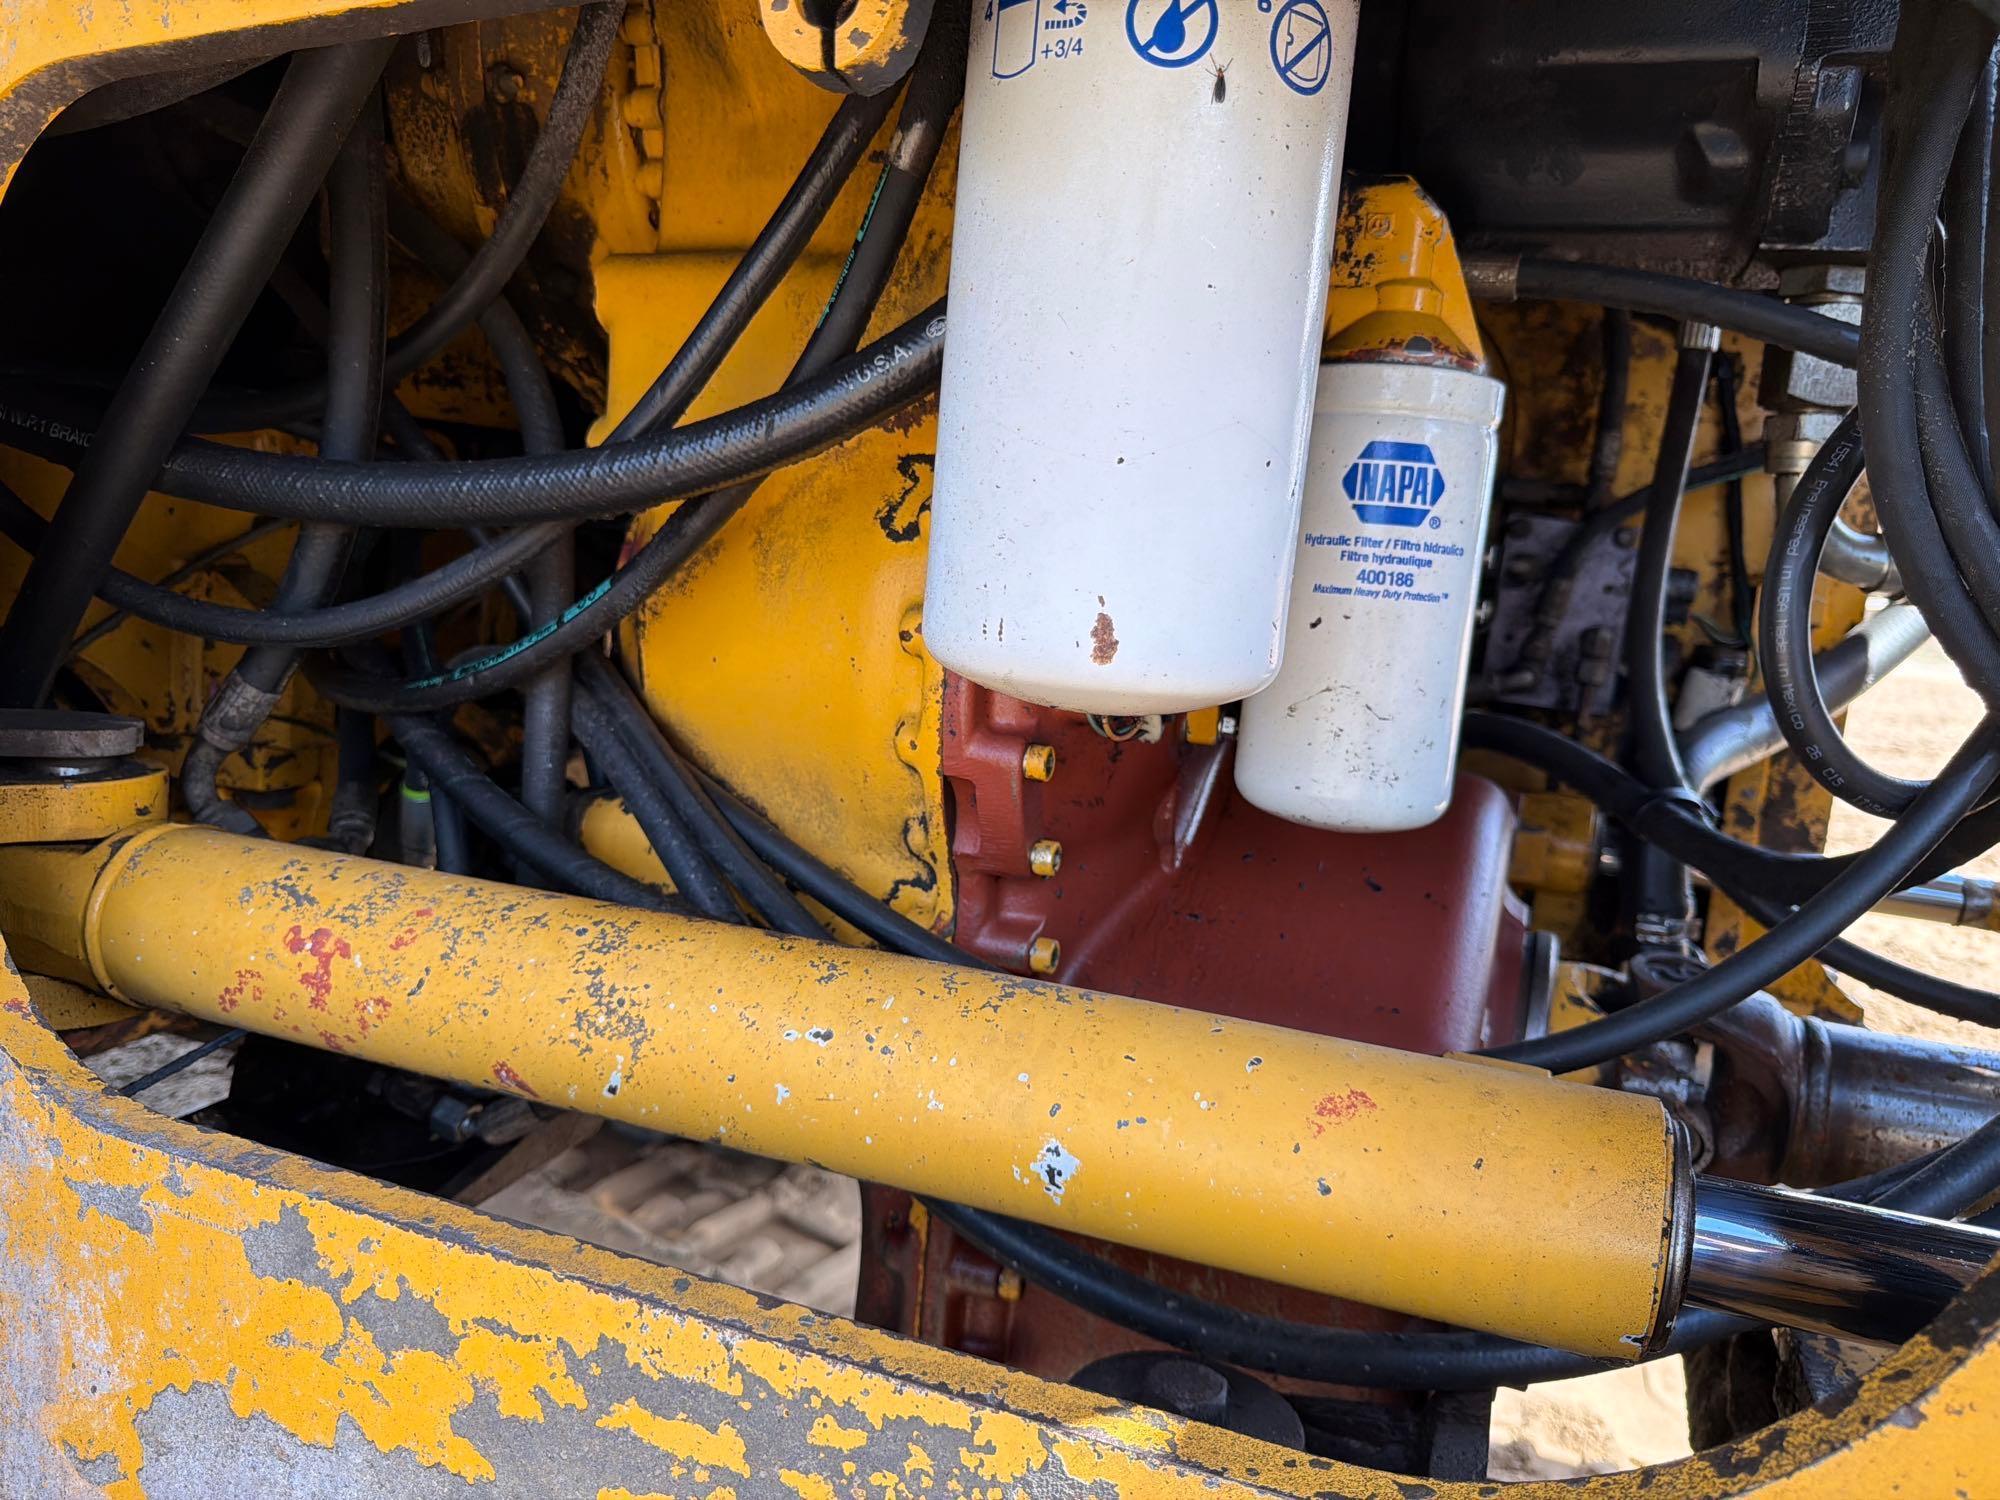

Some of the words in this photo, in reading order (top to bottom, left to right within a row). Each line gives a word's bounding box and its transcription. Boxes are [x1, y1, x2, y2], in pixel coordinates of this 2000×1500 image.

[1041, 37, 1083, 59] +3/4
[855, 345, 913, 383] U.S.A.
[1358, 462, 1428, 506] NAPA
[1786, 480, 1828, 557] Engineered
[1304, 533, 1351, 547] Hydraulic
[1354, 536, 1384, 548] Filter
[1393, 539, 1421, 552] Filtro
[1340, 550, 1369, 562] Filtre
[1372, 553, 1433, 569] hydraulique
[1356, 569, 1414, 587] 400186
[1312, 584, 1352, 595] Maximum
[1354, 587, 1381, 599] Heavy
[1382, 589, 1401, 601] Duty
[1776, 586, 1792, 613] USA
[1775, 619, 1789, 653] Made
[1781, 683, 1805, 730] Mexico
